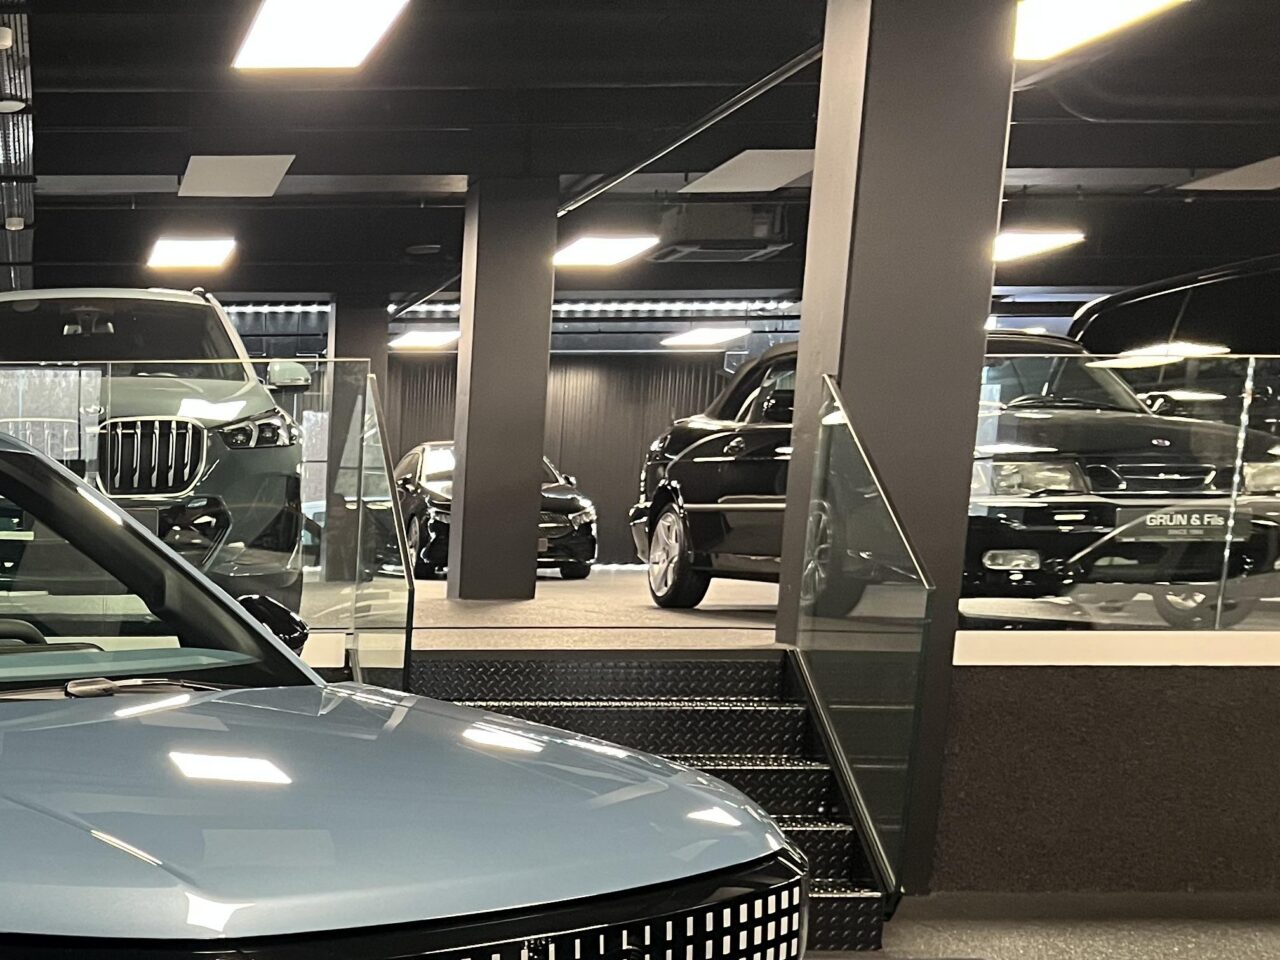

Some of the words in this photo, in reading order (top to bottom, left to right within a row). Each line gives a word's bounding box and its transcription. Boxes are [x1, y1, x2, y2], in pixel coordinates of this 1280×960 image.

[1146, 511, 1188, 526] GRÜN
[1190, 514, 1201, 526] &
[1203, 513, 1225, 526] Fils
